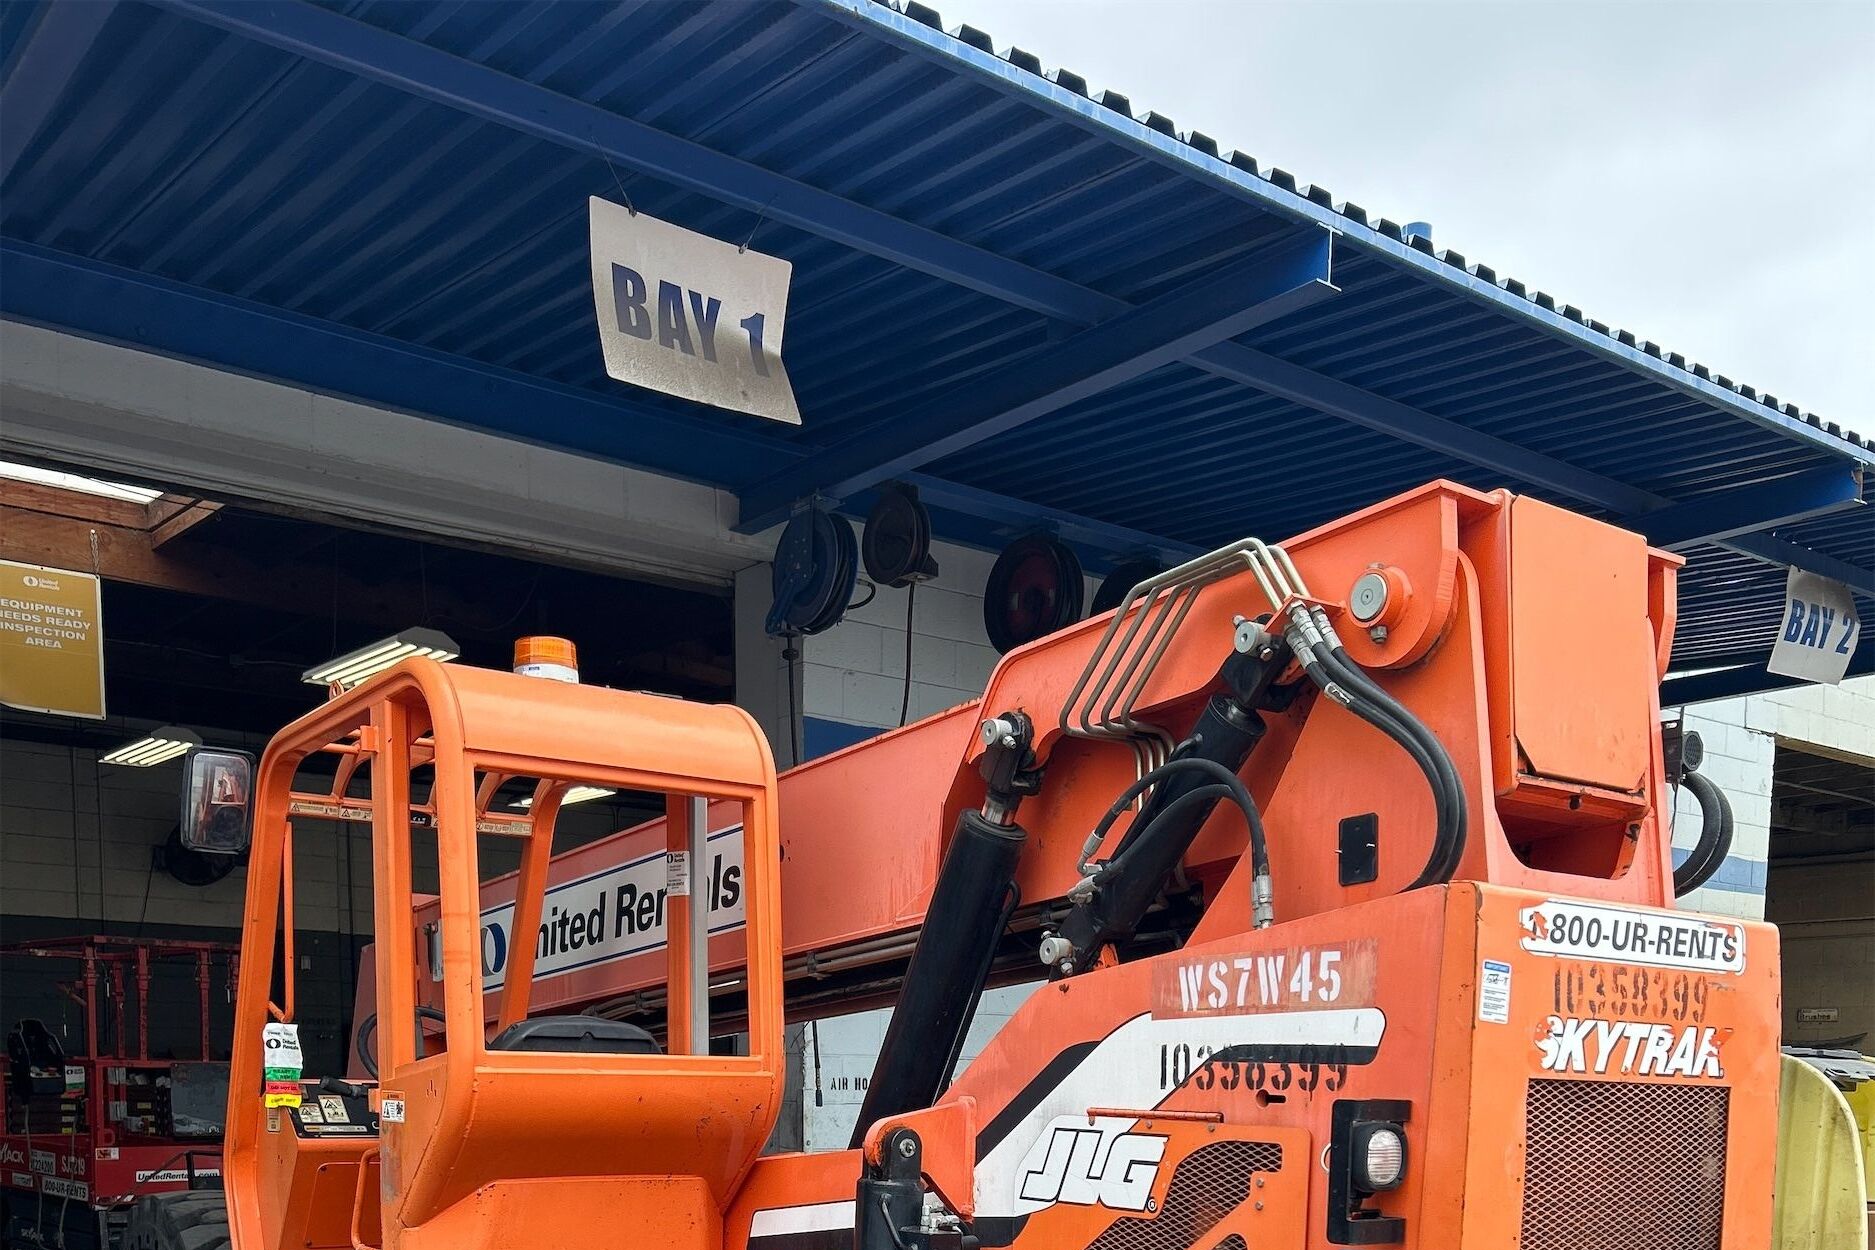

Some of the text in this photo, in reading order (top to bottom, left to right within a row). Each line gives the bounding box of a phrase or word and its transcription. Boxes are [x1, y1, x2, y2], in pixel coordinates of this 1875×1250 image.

[611, 262, 770, 378] BAY 1
[0, 598, 83, 618] EQUIPMENT
[0, 622, 86, 641] INSPECTION
[45, 615, 91, 630] READY
[1784, 599, 1856, 655] BAY 2
[25, 636, 62, 649] AREA
[535, 891, 606, 960] nited
[1179, 950, 1342, 1013] WS7W45
[1554, 962, 1709, 1023] 10358399
[830, 1077, 869, 1091] AIR HO
[1020, 1127, 1172, 1213] JLG
